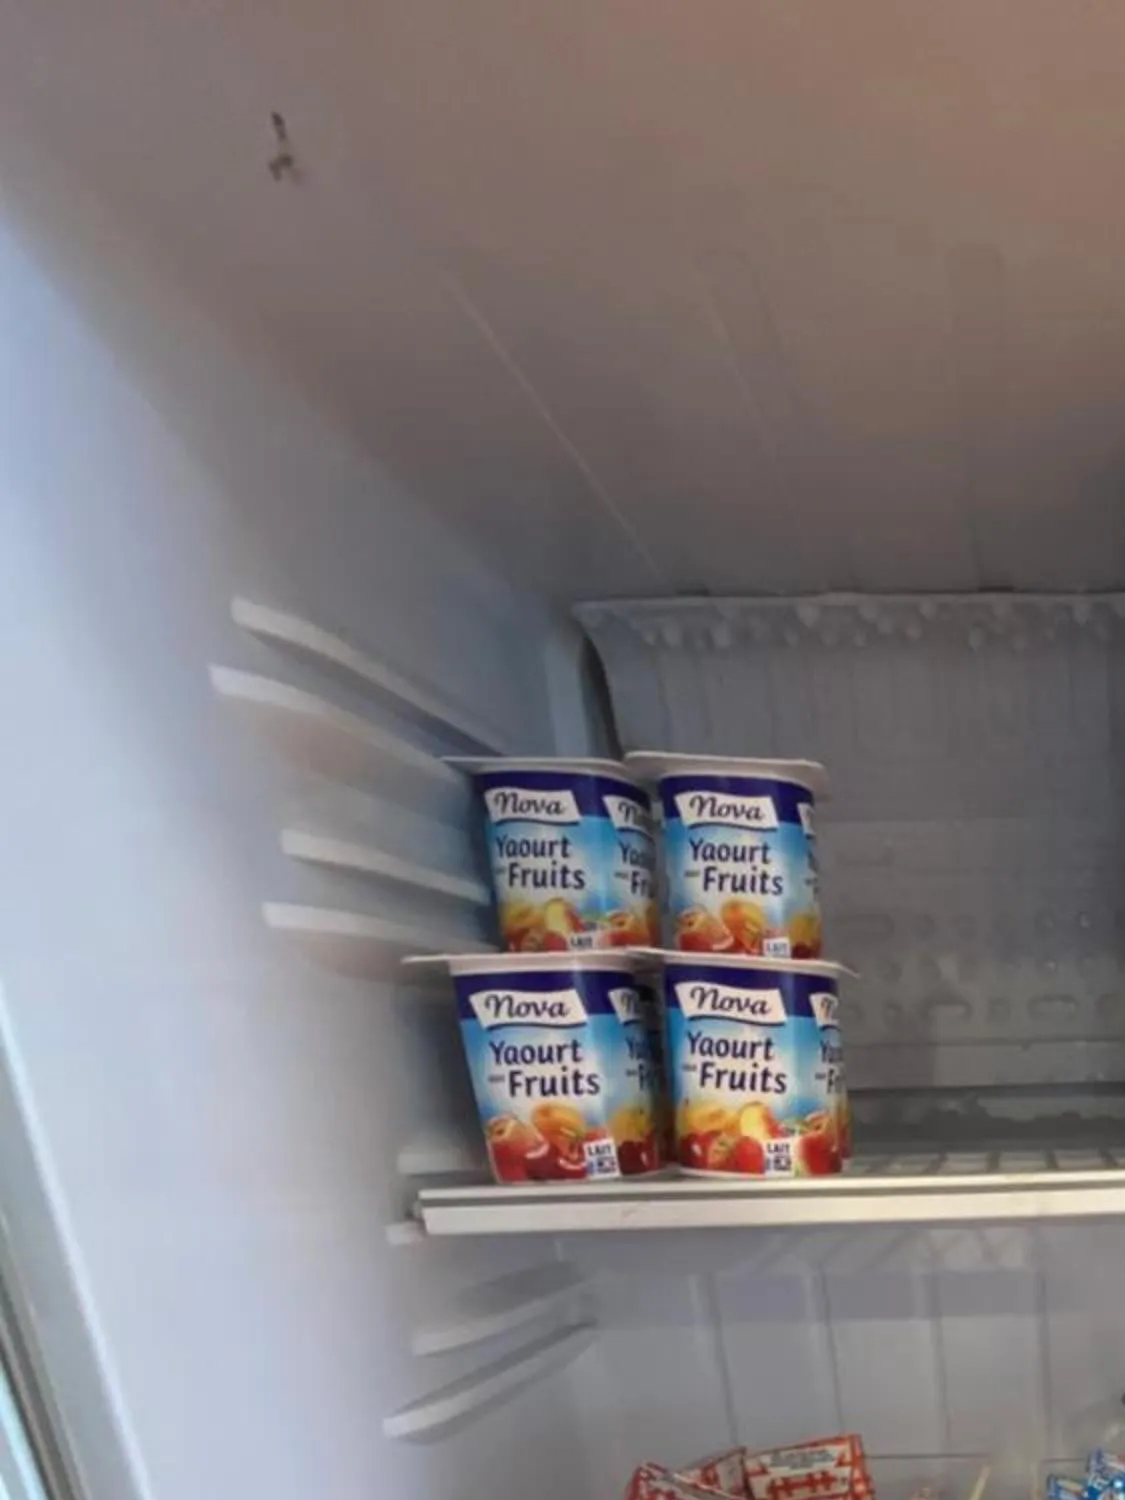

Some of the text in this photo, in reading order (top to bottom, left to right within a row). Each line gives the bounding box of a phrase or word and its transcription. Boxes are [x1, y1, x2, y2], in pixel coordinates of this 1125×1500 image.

[494, 791, 566, 816] Nova
[689, 794, 765, 821] Nova
[495, 832, 572, 859] Yaourt
[688, 836, 773, 865] Yaourt
[508, 859, 587, 890] Fruits
[703, 865, 785, 896] Fruits
[484, 993, 571, 1018] Nova
[690, 985, 772, 1016] Nova
[488, 1039, 583, 1066] Yaourt
[687, 1030, 774, 1061] Yaourt
[508, 1065, 602, 1099] Fruits
[699, 1061, 789, 1095] Fruits
